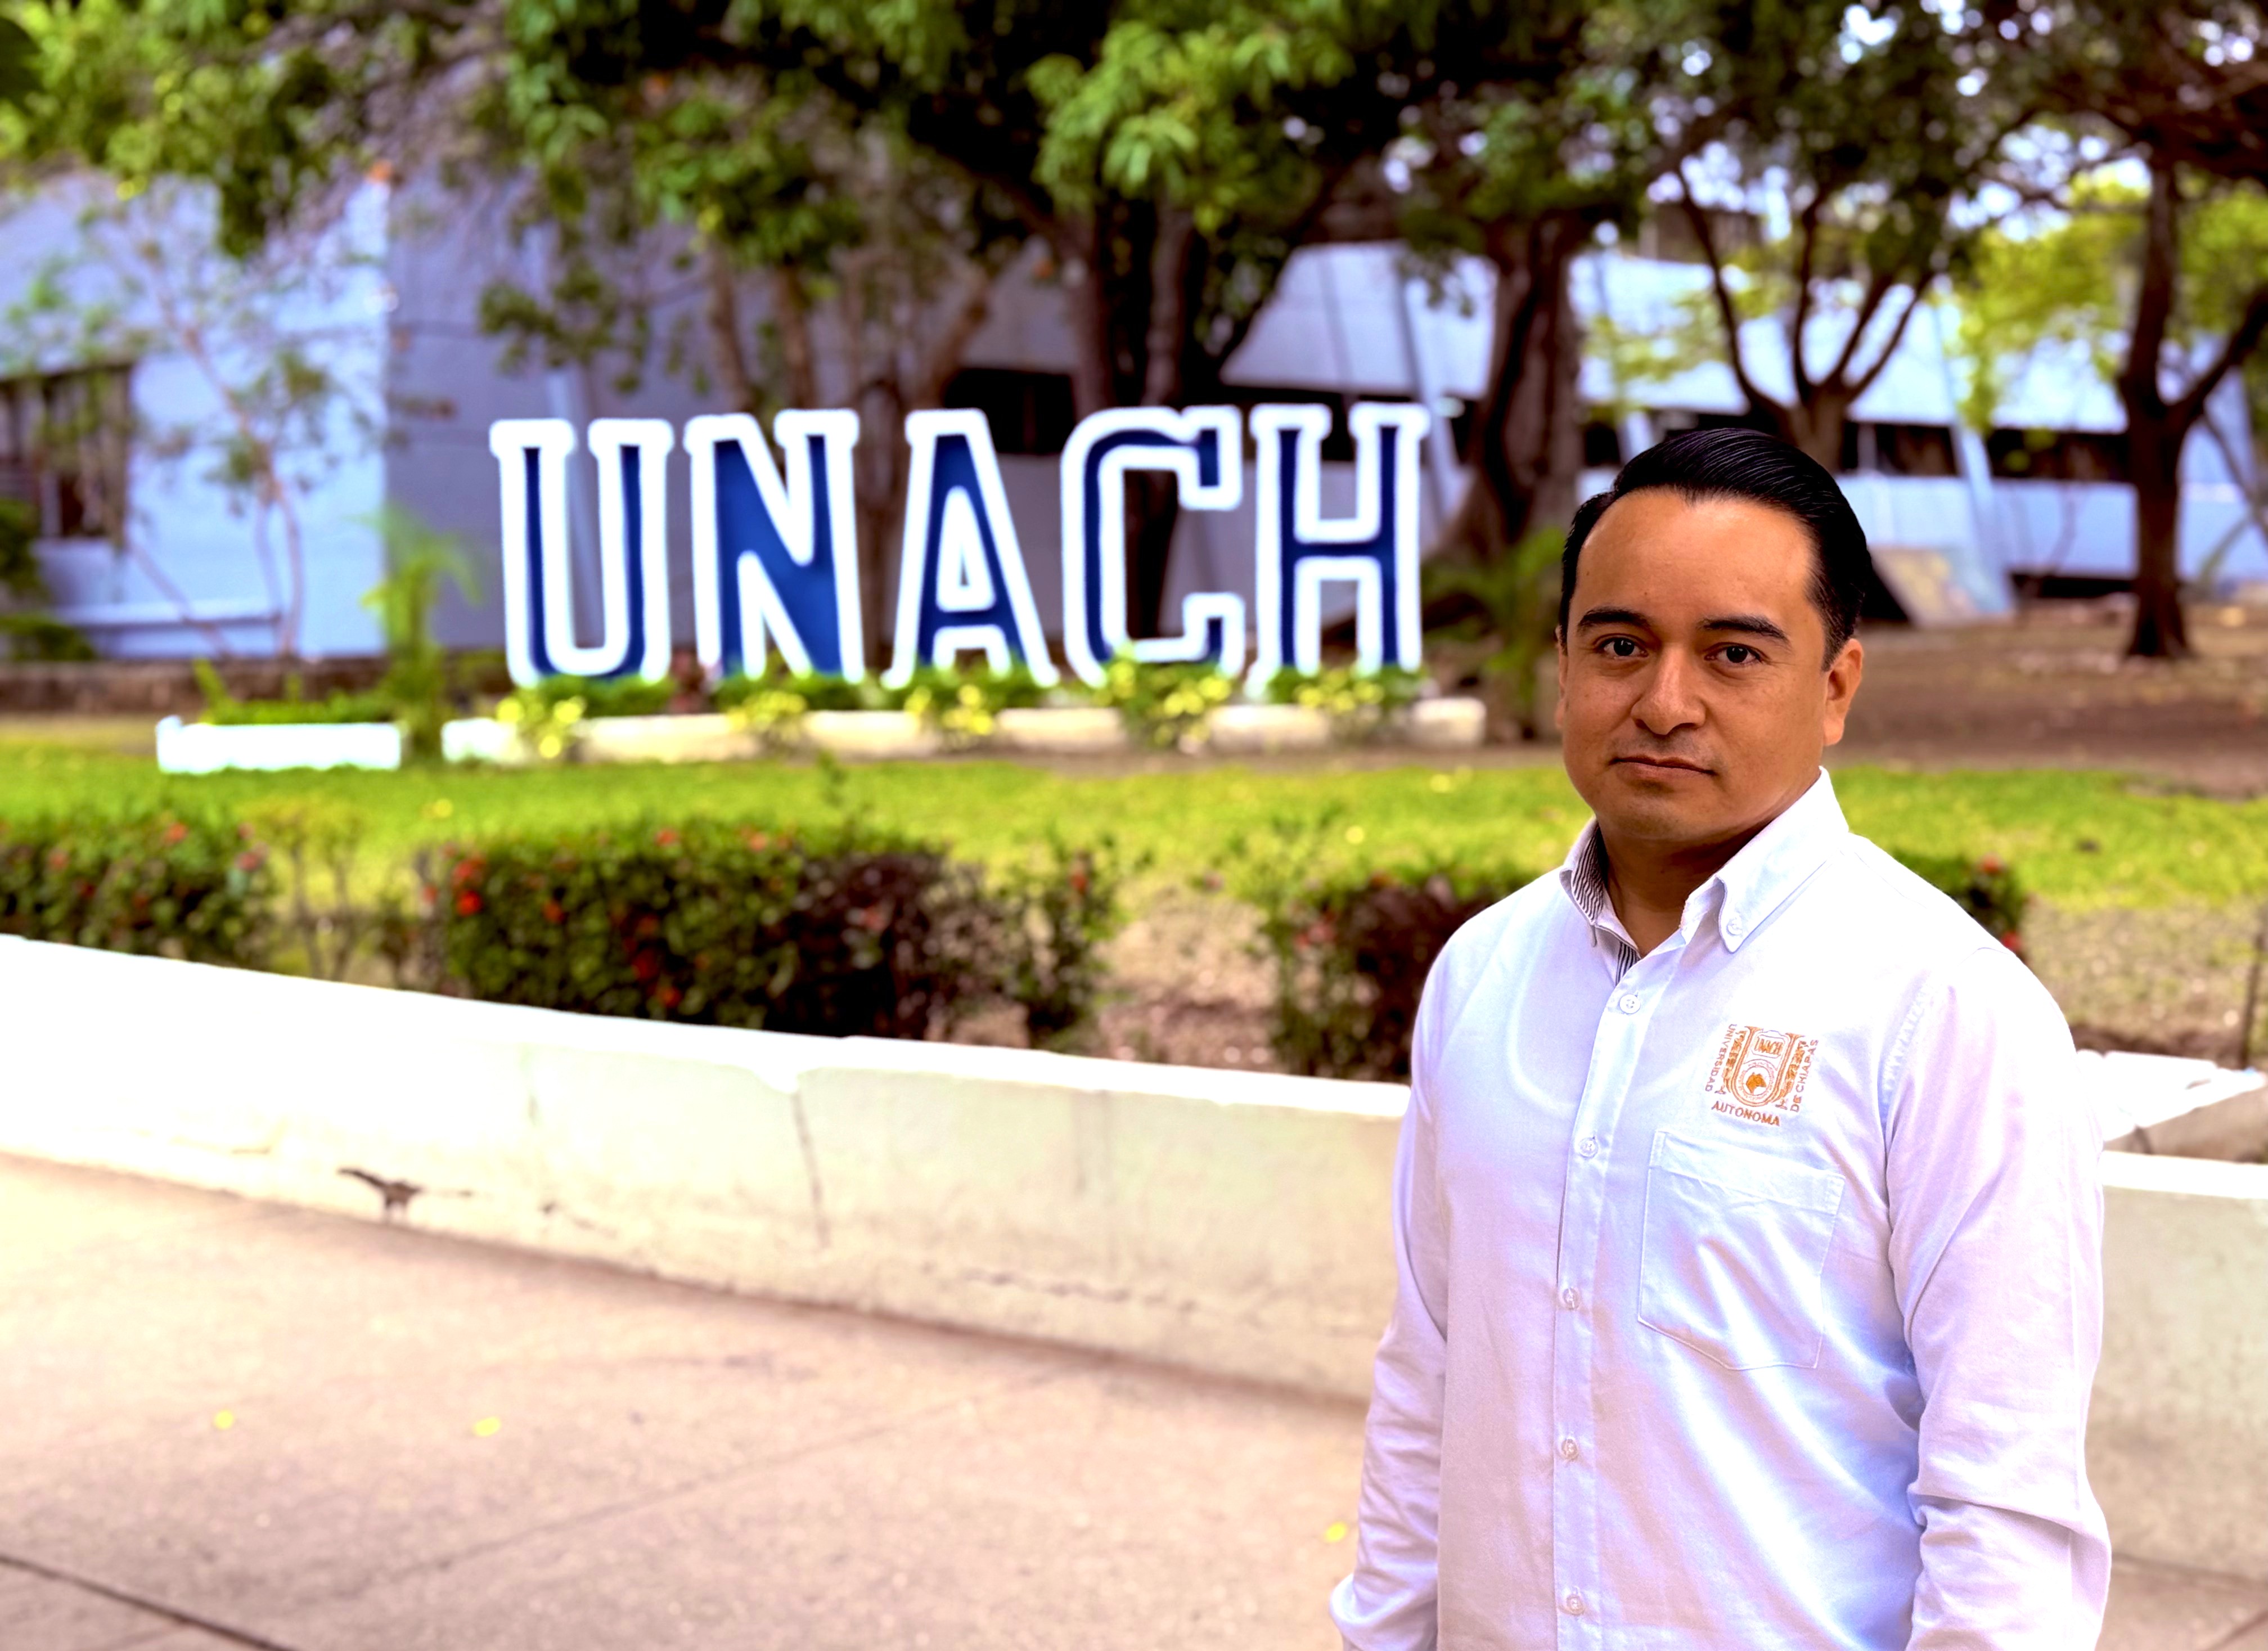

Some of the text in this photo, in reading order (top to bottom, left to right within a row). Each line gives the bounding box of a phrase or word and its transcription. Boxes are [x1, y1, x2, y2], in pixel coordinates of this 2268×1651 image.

[488, 403, 1430, 690] UNACH
[1704, 1023, 1737, 1092] UNIVERSIDAD
[1790, 1039, 1819, 1113] DE CHIAPAS
[1711, 1100, 1780, 1127] AUTONOMA
